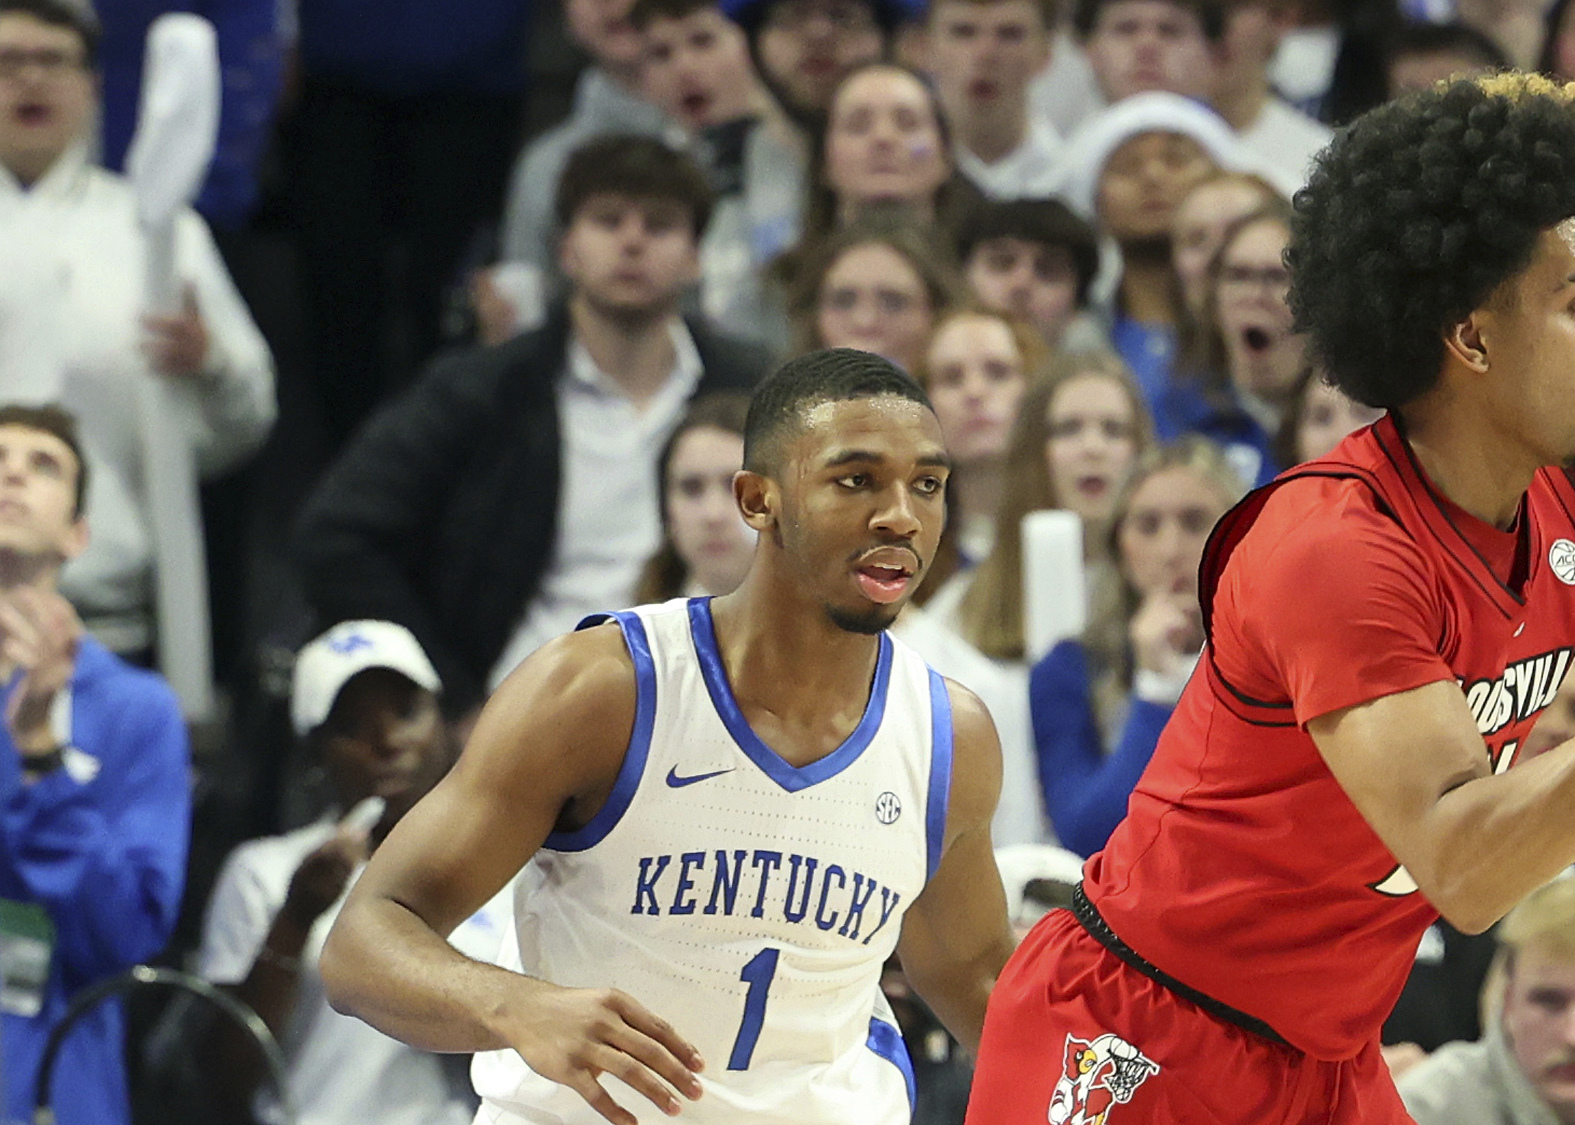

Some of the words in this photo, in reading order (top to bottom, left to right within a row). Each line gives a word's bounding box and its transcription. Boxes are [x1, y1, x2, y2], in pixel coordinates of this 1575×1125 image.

[876, 791, 901, 825] SEC
[630, 849, 900, 945] KENTUCKY
[726, 947, 780, 1071] 1
